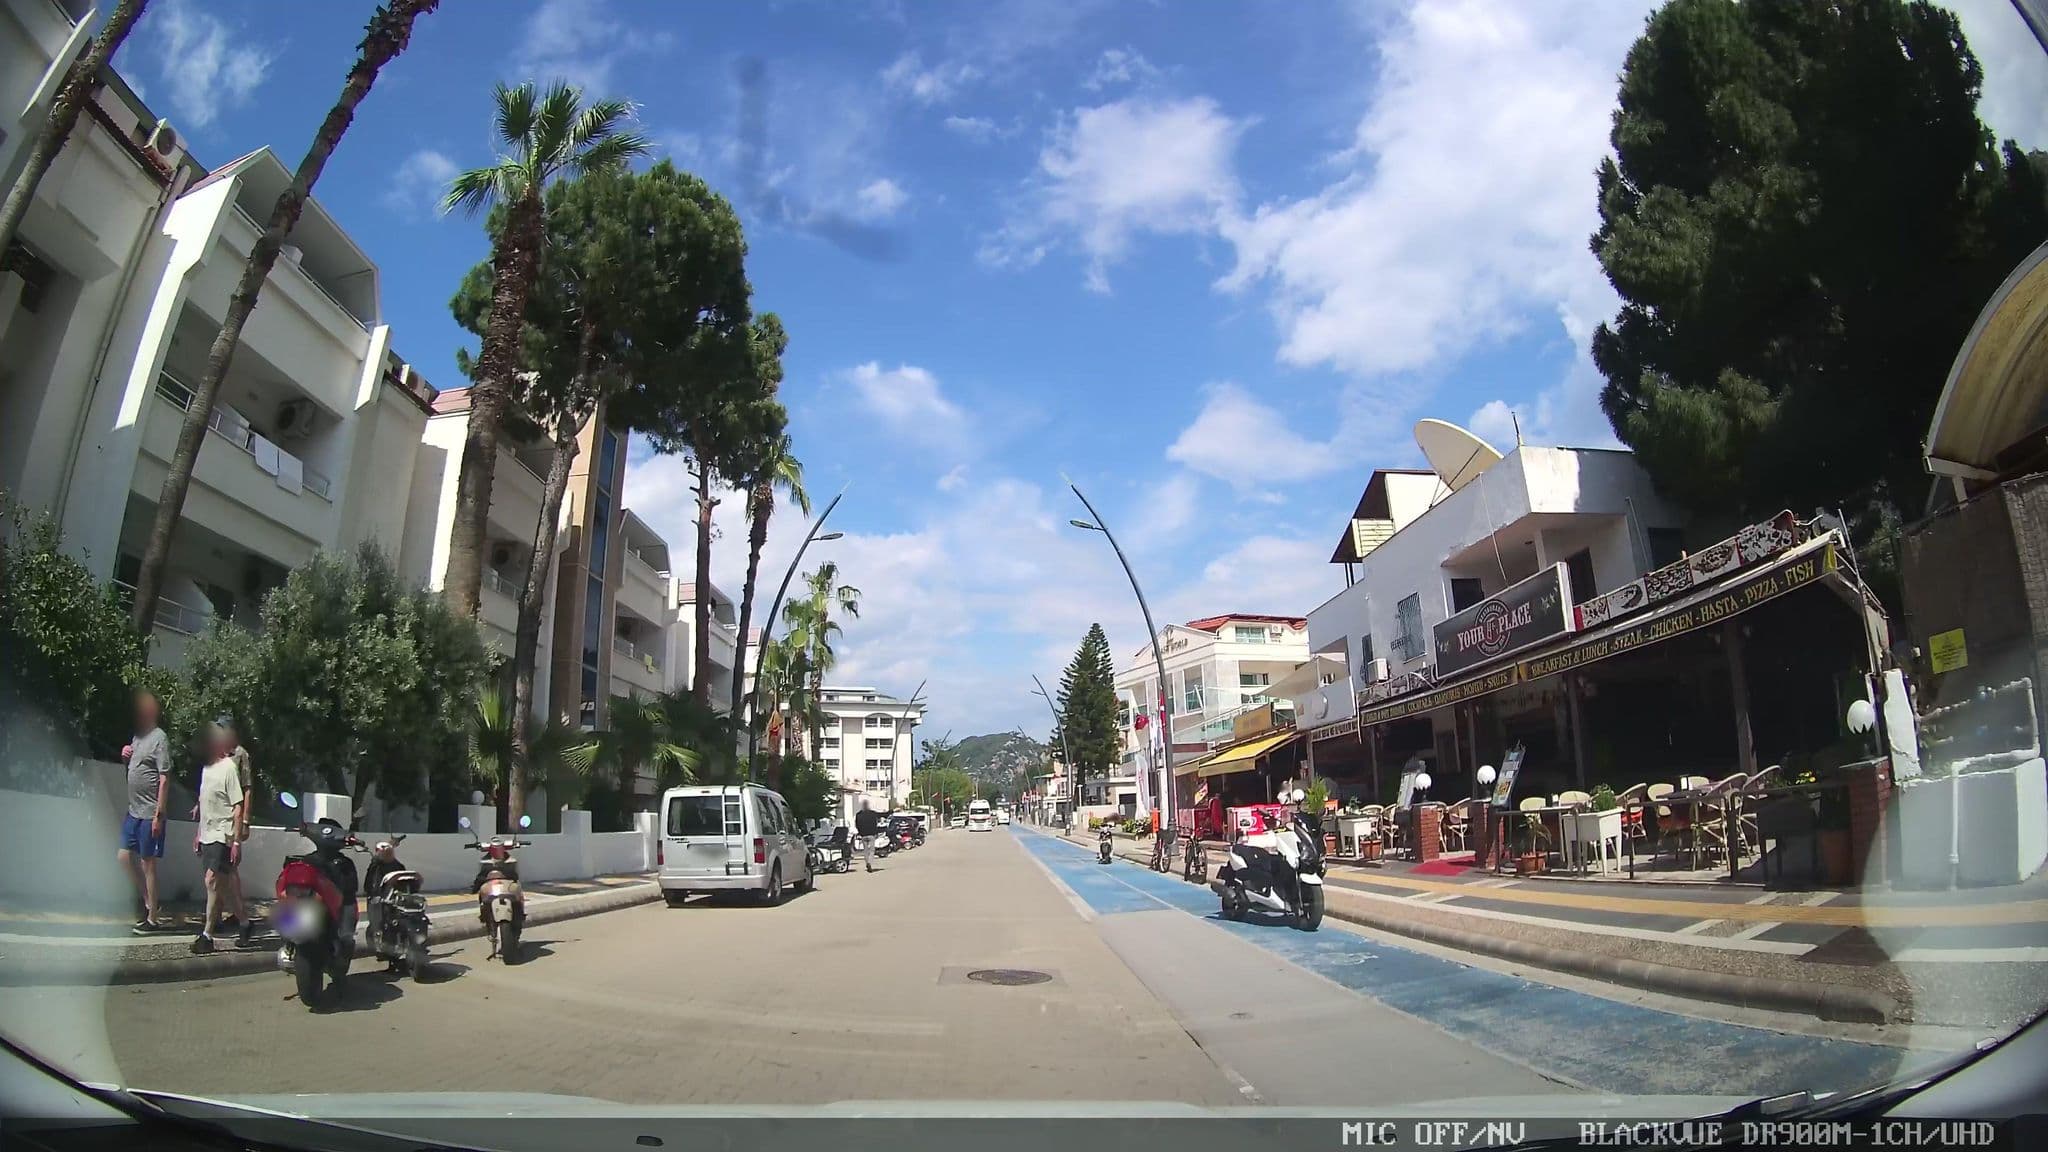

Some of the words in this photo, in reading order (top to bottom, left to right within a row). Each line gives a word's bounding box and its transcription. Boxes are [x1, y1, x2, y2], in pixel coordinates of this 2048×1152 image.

[1457, 625, 1485, 652] YOUR
[1497, 601, 1533, 634] PLACE
[1531, 652, 1572, 677] BREAKFAST
[1582, 641, 1608, 661] LUNCH
[1613, 628, 1643, 652] STEAK
[1648, 611, 1693, 640] CHICKEN
[1743, 577, 1779, 605] PIZZA
[1784, 559, 1815, 587] FISH
